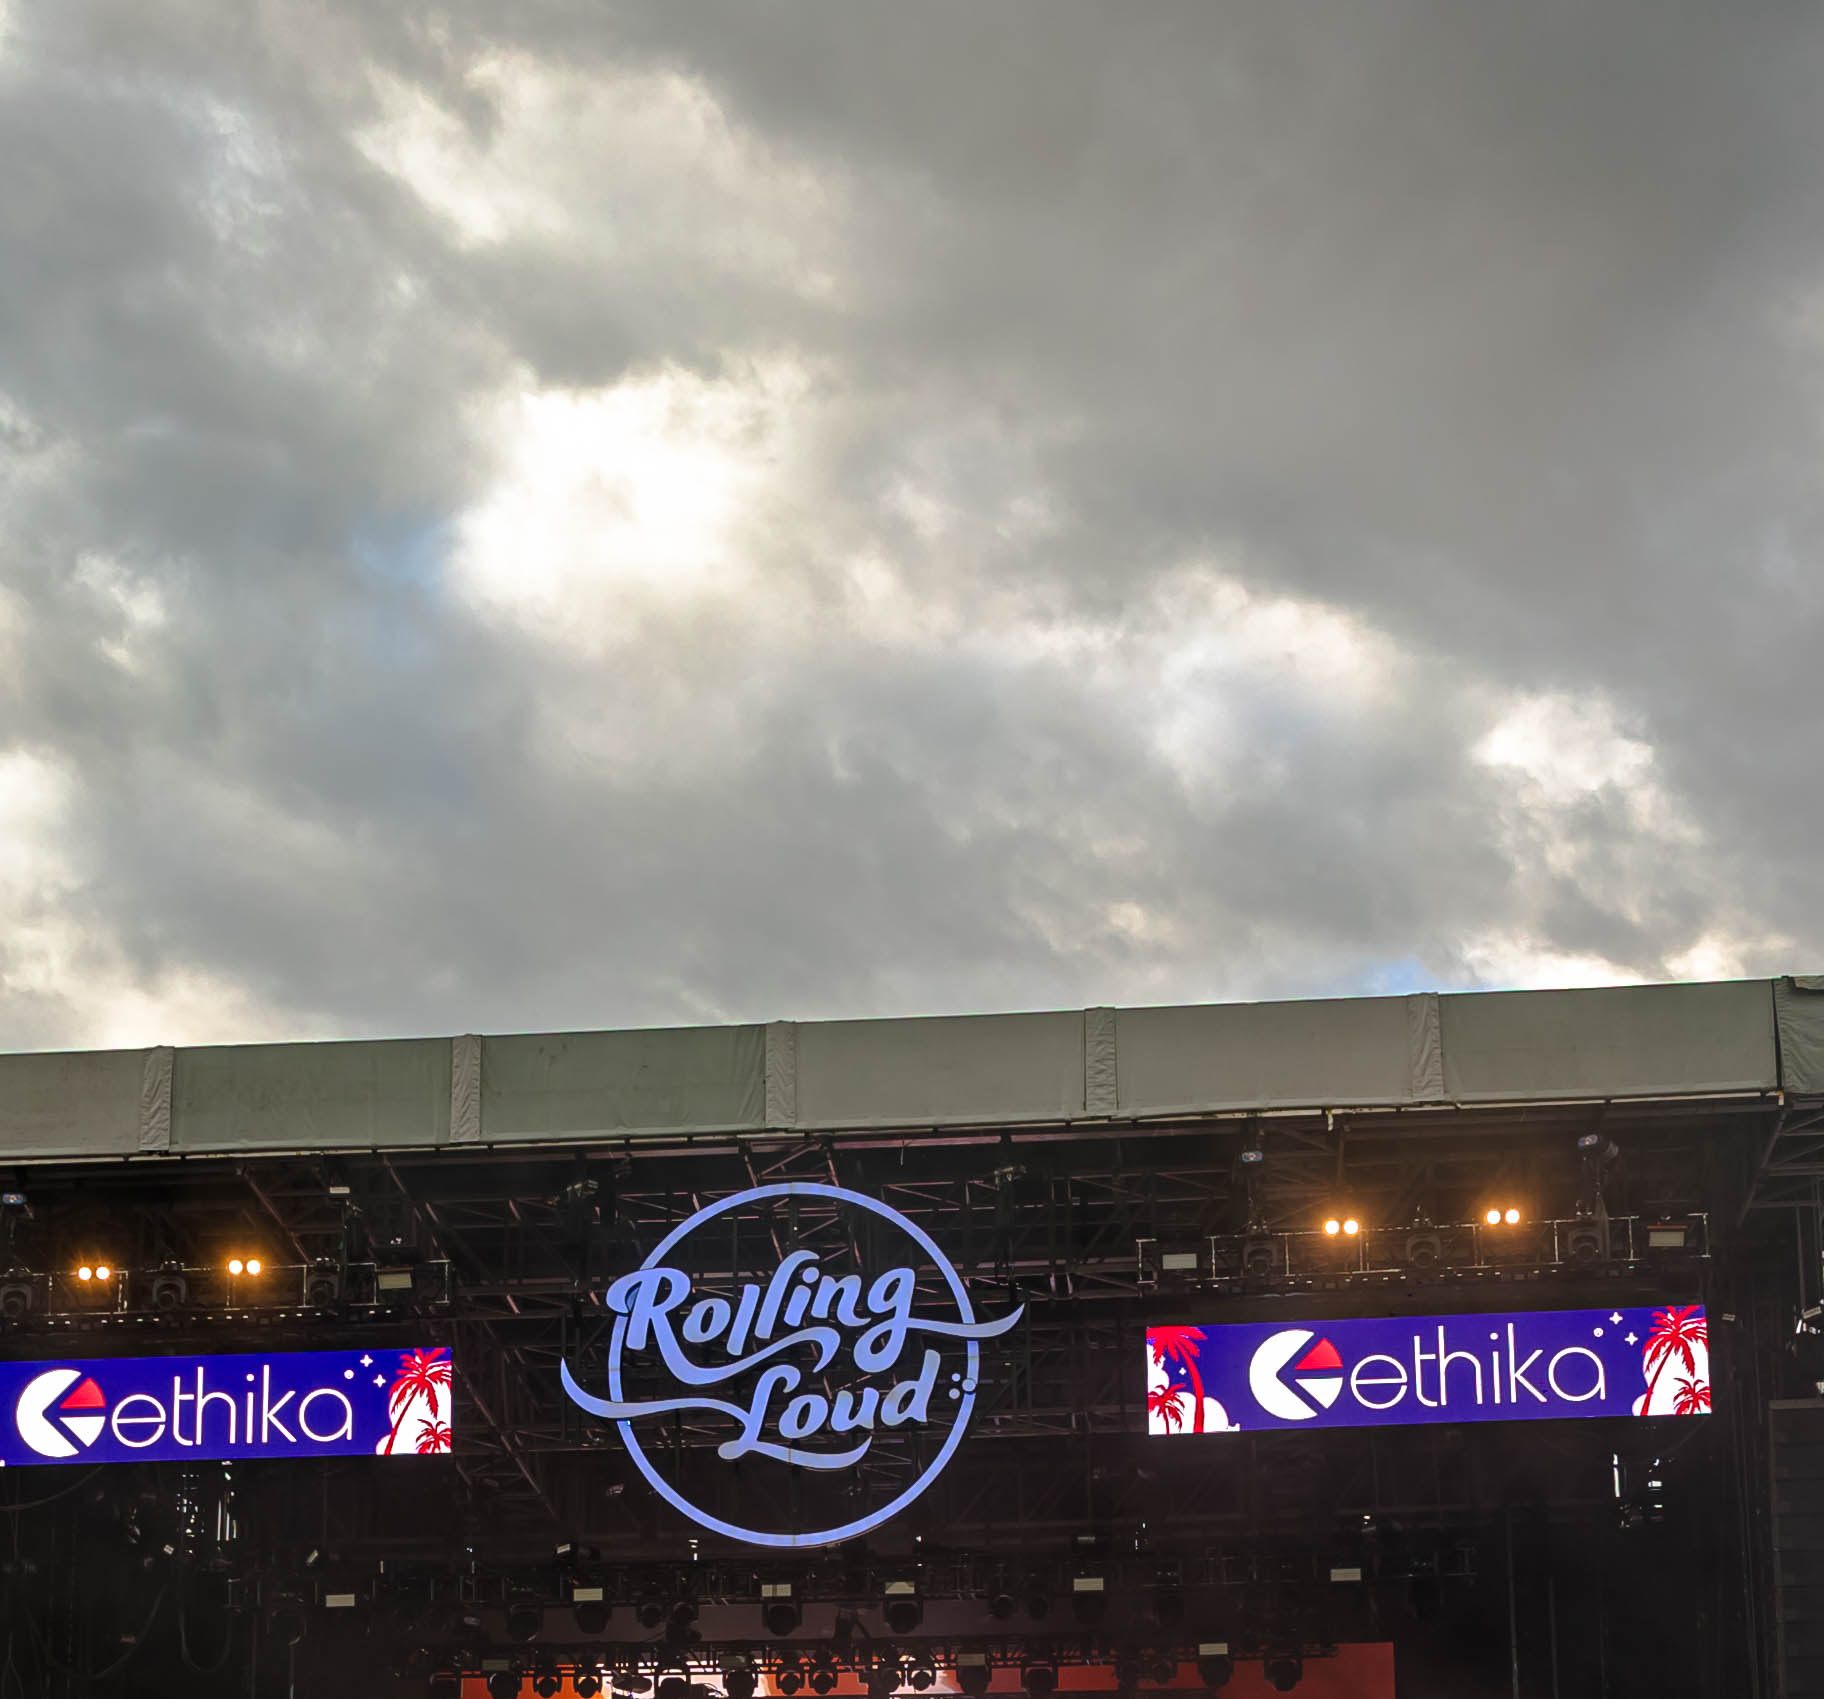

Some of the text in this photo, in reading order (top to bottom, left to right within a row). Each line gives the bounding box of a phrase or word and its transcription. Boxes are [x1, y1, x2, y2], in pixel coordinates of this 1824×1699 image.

[606, 1250, 1025, 1385] Rolling
[1350, 1322, 1606, 1410] ethika
[111, 1364, 353, 1448] ethika
[561, 1348, 941, 1471] Loud
